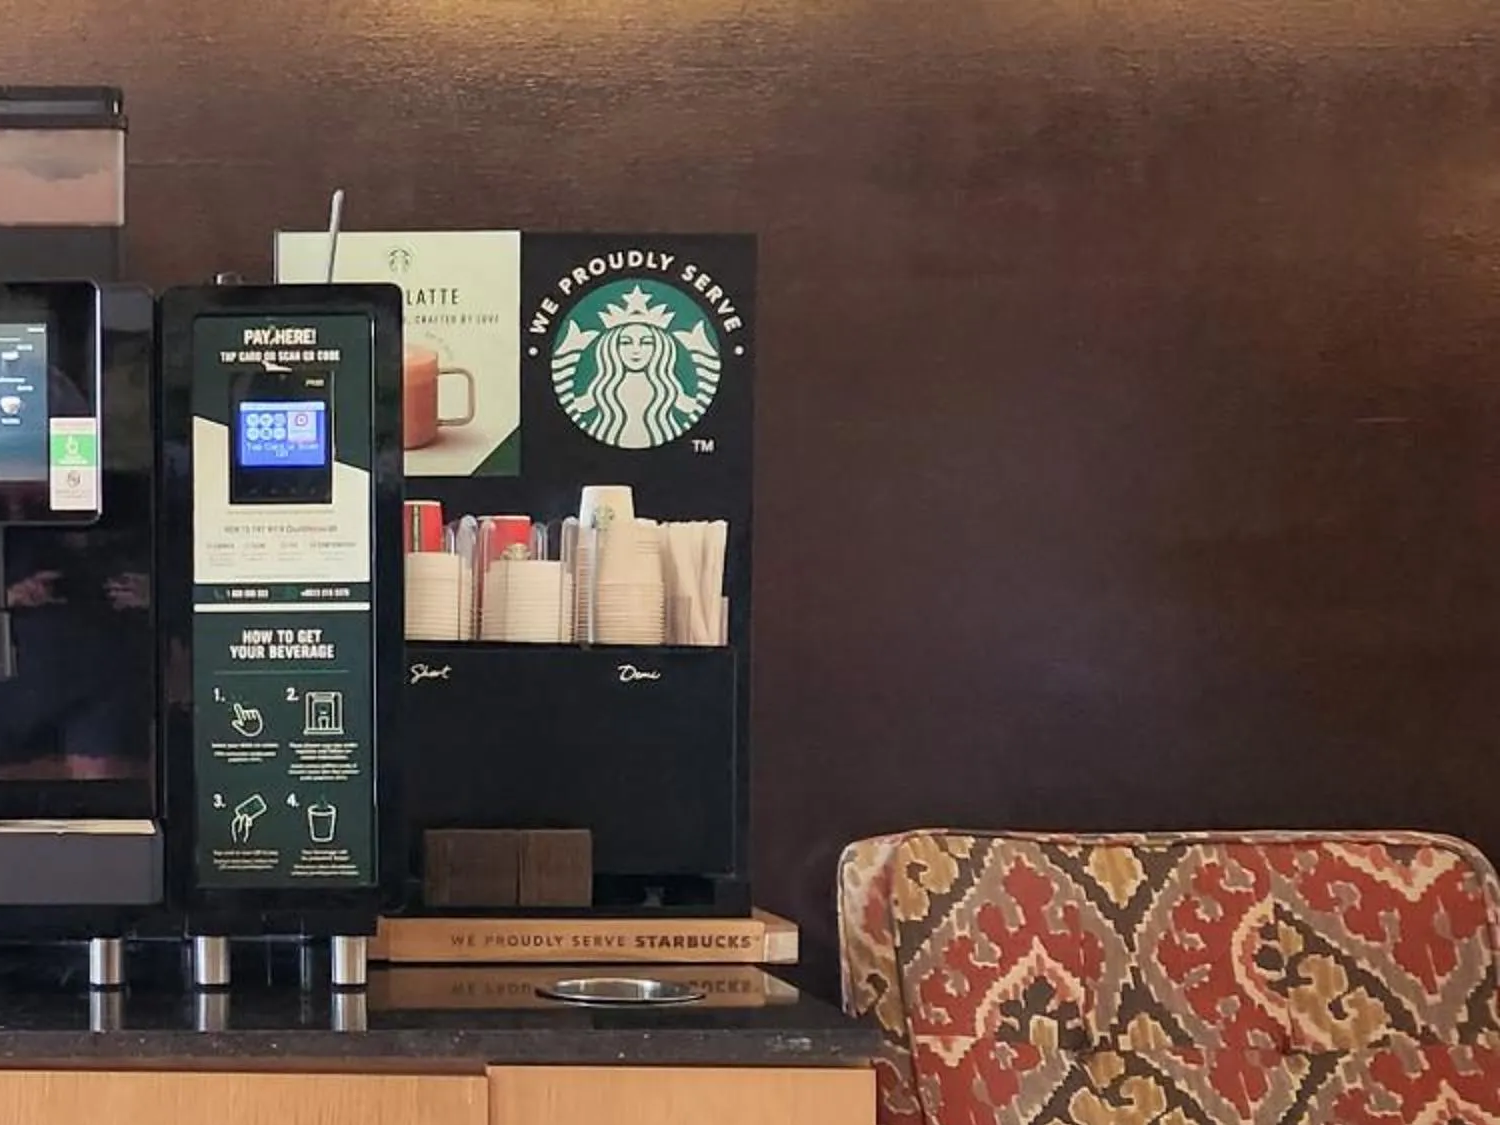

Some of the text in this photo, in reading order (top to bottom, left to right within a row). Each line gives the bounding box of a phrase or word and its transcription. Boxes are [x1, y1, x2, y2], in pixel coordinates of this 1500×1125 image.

[406, 288, 460, 305] LATTE
[529, 250, 743, 336] WE PROUDLY SERVE
[243, 328, 317, 345] PAY HERE!
[278, 350, 301, 362] SCAN
[317, 349, 341, 361] CODE
[692, 439, 715, 453] TM
[242, 629, 323, 644] HOW TO GET
[230, 644, 335, 660] YOUR BEVERAGE
[451, 934, 752, 949] WE PROUDLY SERVE STARBUCKS
